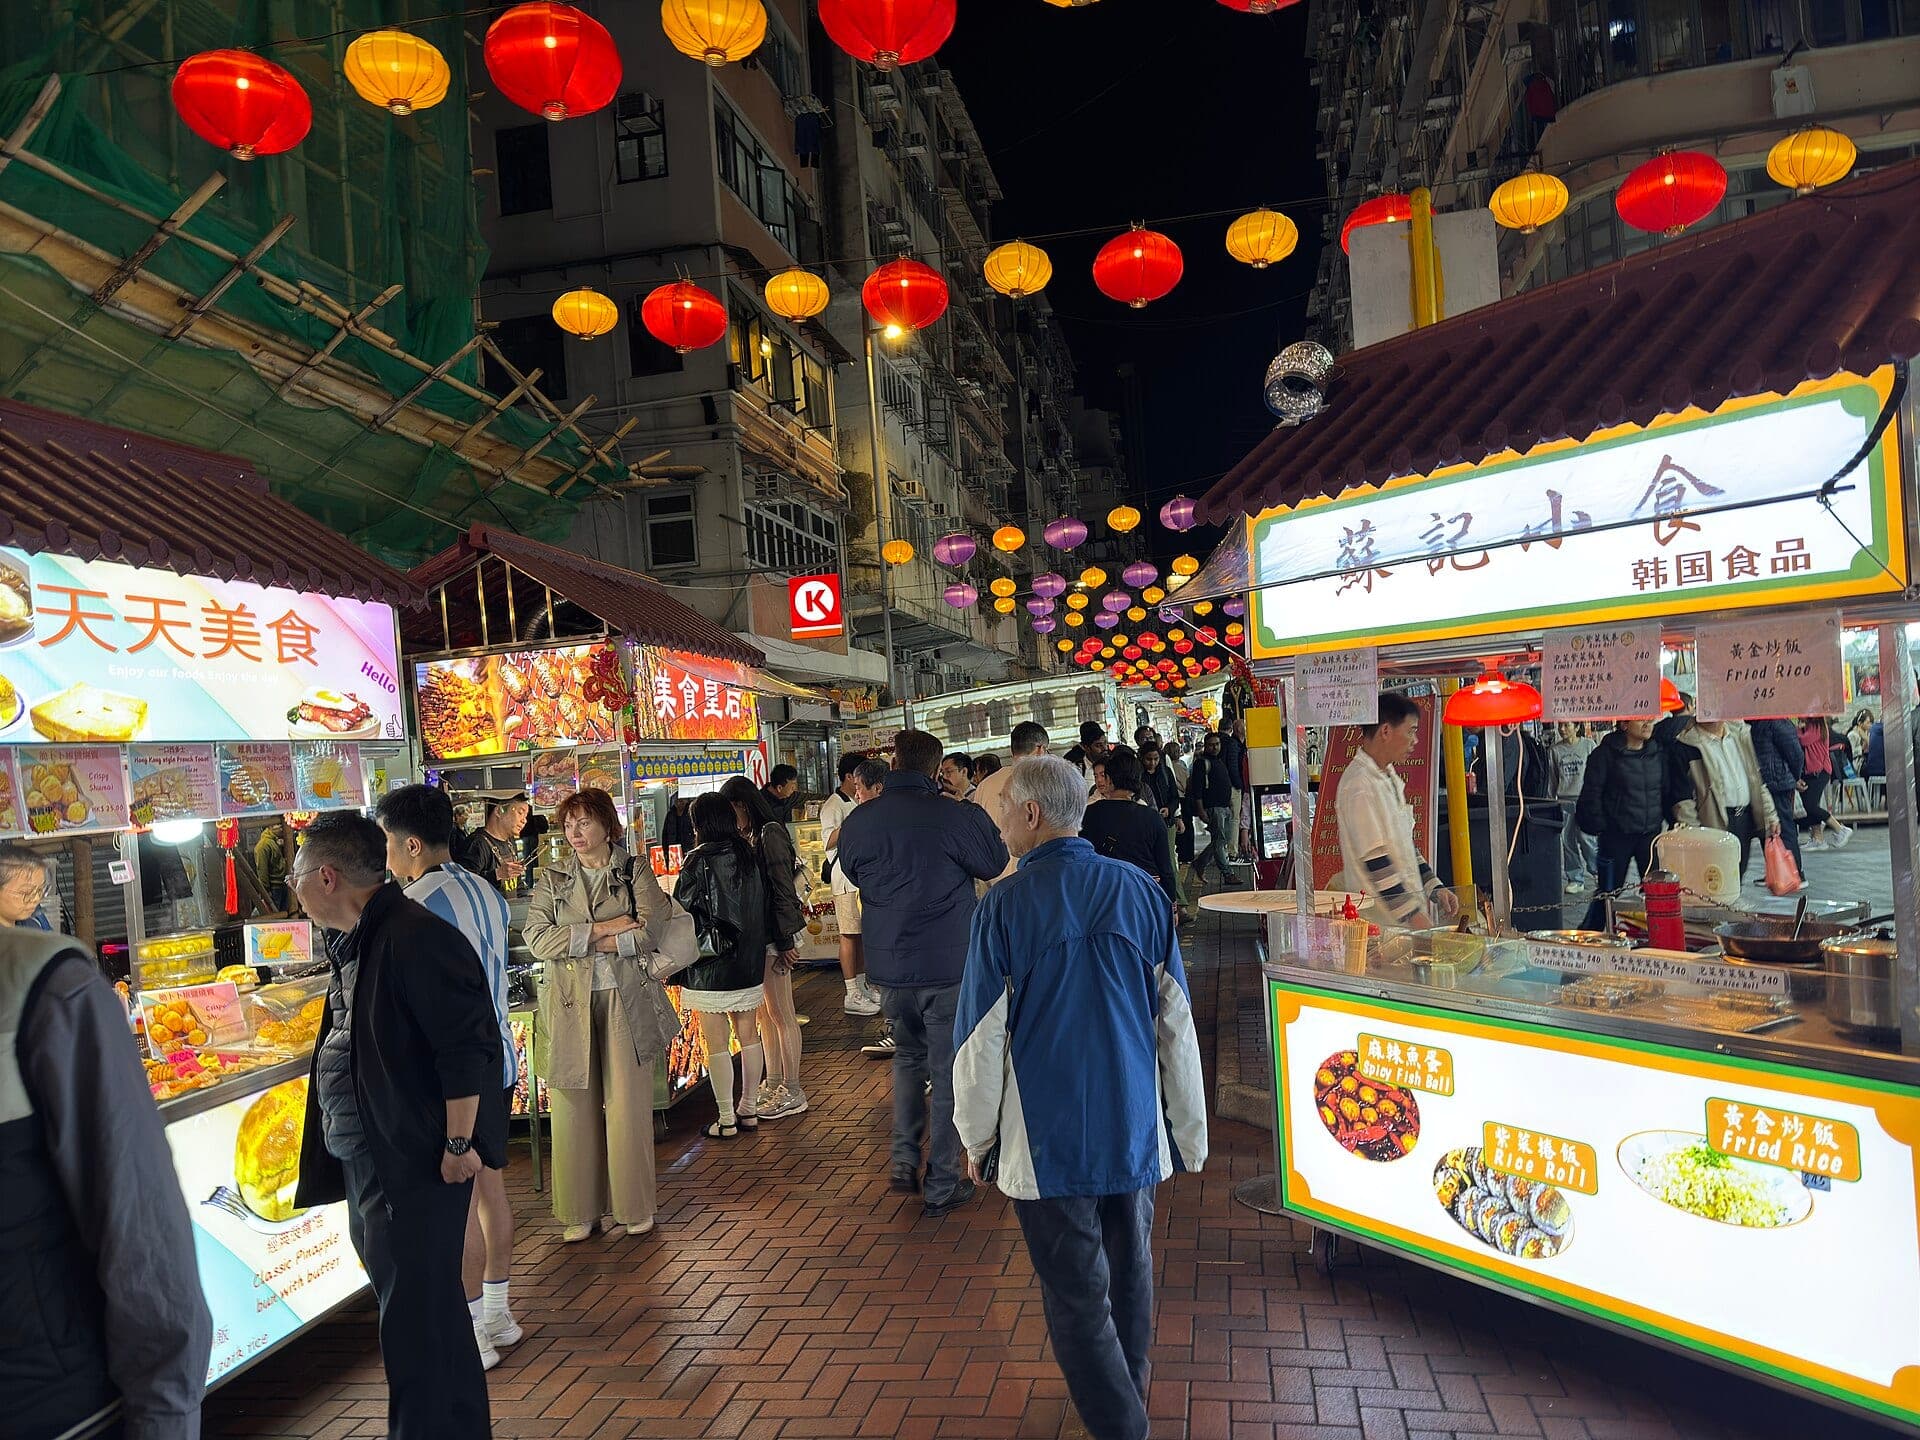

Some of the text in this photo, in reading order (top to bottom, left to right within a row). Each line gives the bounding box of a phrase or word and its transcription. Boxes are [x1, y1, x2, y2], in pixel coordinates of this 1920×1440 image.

[1335, 454, 1725, 597] 蘇記小食
[1631, 537, 1811, 590] 韩国食品
[36, 584, 320, 667] 天天美食
[1635, 651, 1650, 660] $40
[1730, 638, 1802, 660] 黃金炒飯
[108, 664, 144, 680] Enjoy
[147, 668, 168, 679] our
[361, 661, 396, 693] Hello
[1634, 675, 1648, 683] $40
[1726, 664, 1811, 682] Fried Rice
[653, 668, 741, 720] 美食皇后
[1634, 700, 1649, 708] $40
[1753, 687, 1775, 701] $45
[88, 772, 109, 781] Crispy
[1587, 954, 1600, 963] $40
[1670, 966, 1686, 976] $40
[1762, 975, 1778, 985] $40
[1367, 1037, 1443, 1073] 麻辣魚蛋
[1363, 1060, 1450, 1093] Spicy Fish Ball
[1723, 1103, 1840, 1150] 黃金炒飯
[1722, 1129, 1843, 1174] Fried Rice
[1493, 1147, 1587, 1188] Rice Roll
[253, 1258, 292, 1288] Classic
